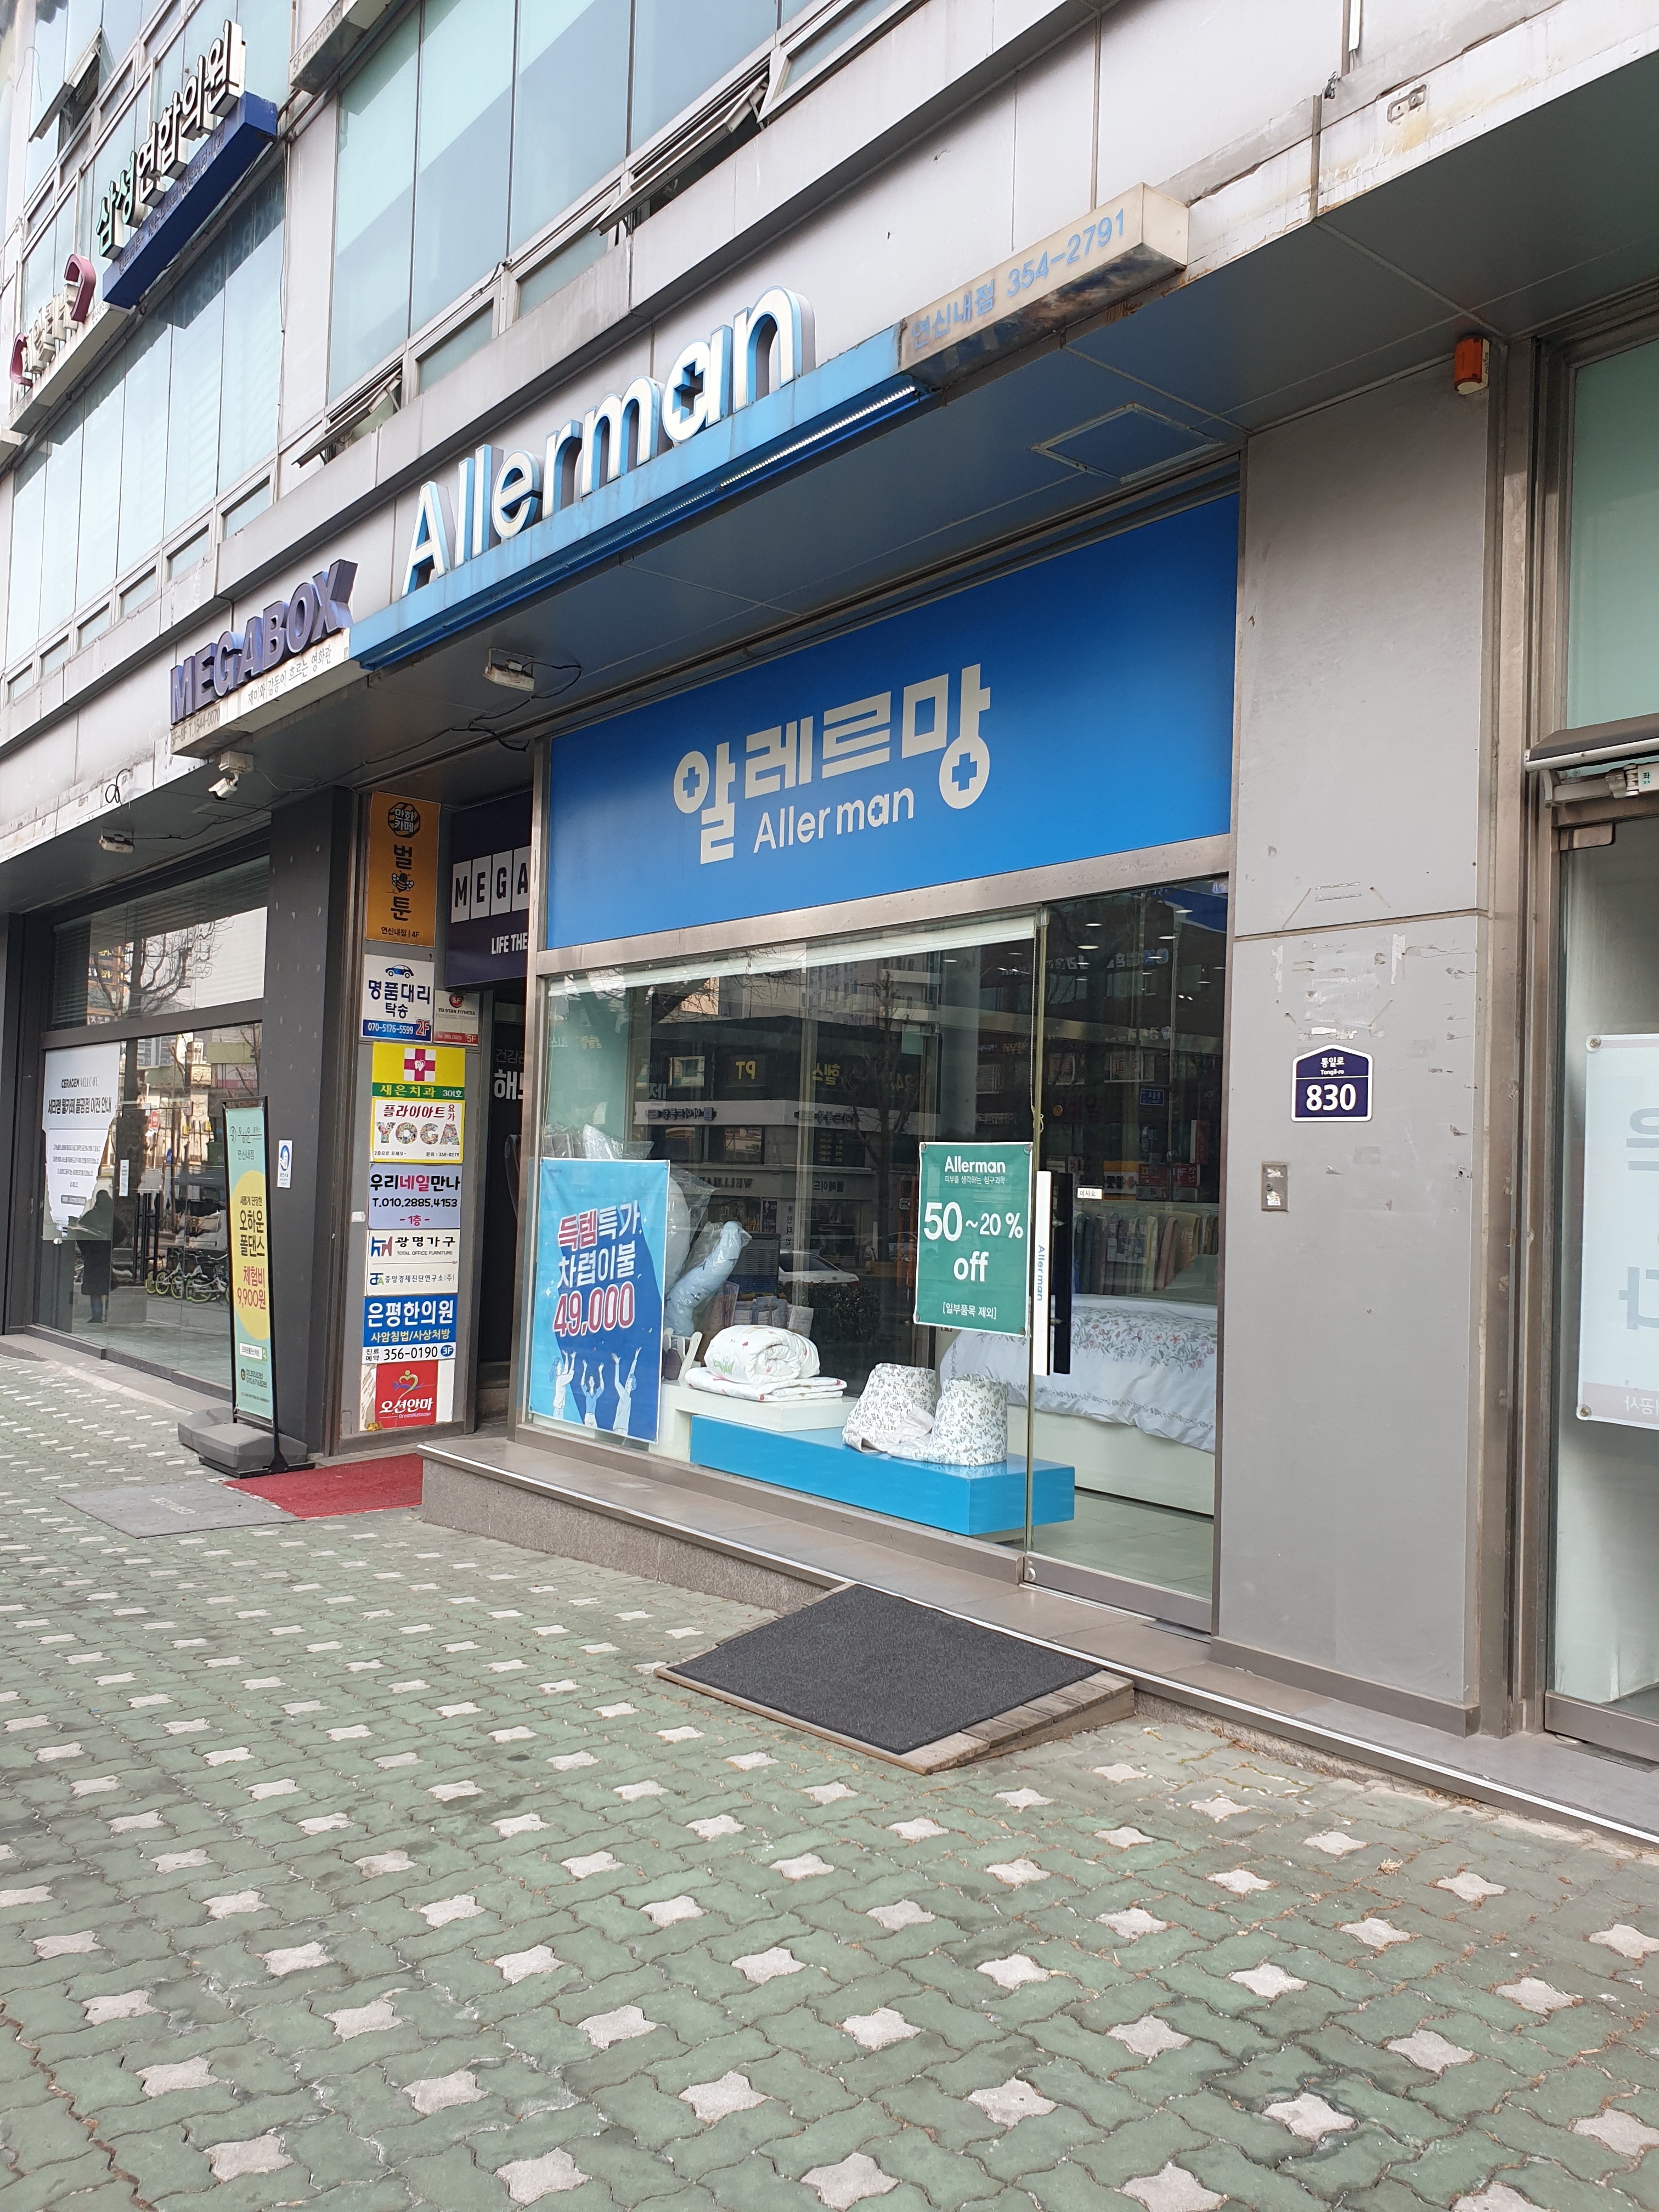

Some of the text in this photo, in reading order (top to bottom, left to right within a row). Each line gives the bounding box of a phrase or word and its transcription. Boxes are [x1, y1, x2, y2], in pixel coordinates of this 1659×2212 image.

[96, 19, 245, 260] 삼성연합의원
[911, 208, 1125, 349] 연신내점 354-2791
[401, 285, 816, 598] Allerman
[171, 559, 358, 725] MEGABOX
[247, 644, 332, 706] 재미와 감동이 흐르는 영화관
[674, 663, 991, 865] 알레르망
[394, 808, 414, 822] 만화
[753, 788, 915, 854] Allerman
[394, 820, 414, 833] 카페
[381, 926, 420, 939] 연신내점 4F
[492, 935, 509, 955] LIFE
[368, 979, 431, 1005] 명품대리
[385, 1002, 409, 1019] 탁송
[368, 1019, 431, 1036] 070-5176-5599 2F
[466, 1035, 477, 1043] 5F
[1320, 1056, 1345, 1069] 통일로
[61, 1078, 80, 1089] CERAGEM
[380, 1084, 462, 1098] 새은치과 301호
[494, 1069, 524, 1101] 해
[76, 1098, 91, 1114] 불광점
[91, 1097, 101, 1113] 이전
[101, 1097, 112, 1113] 안내
[1306, 1084, 1357, 1111] 830
[383, 1104, 445, 1119] 플라이아트
[375, 1121, 460, 1146] YOGA
[238, 1149, 255, 1160] 연신내점
[944, 1155, 1006, 1173] Allerman
[370, 1173, 461, 1192] 우리네일만나
[944, 1175, 1006, 1185] 피부를 생각하는 침구과학
[372, 1198, 458, 1208] T.010.2885.4153
[1079, 1189, 1096, 1198] 미시오
[240, 1210, 264, 1233] 오하운
[557, 1199, 641, 1252] 득템특가
[240, 1234, 266, 1257] 폴댄스
[394, 1236, 456, 1248] 광명가구
[243, 1265, 265, 1288] 체험비
[556, 1243, 636, 1290] 차렵이불
[953, 1250, 989, 1283] off
[1036, 1244, 1046, 1302] Allerman
[237, 1287, 267, 1310] 9,900원
[552, 1280, 636, 1337] 49,000
[368, 1299, 453, 1328] 은평한의원
[371, 1328, 451, 1344] 사암침법/사상처방
[383, 1346, 453, 1361] 356-0190 3F
[379, 1397, 433, 1414] 오션안마
